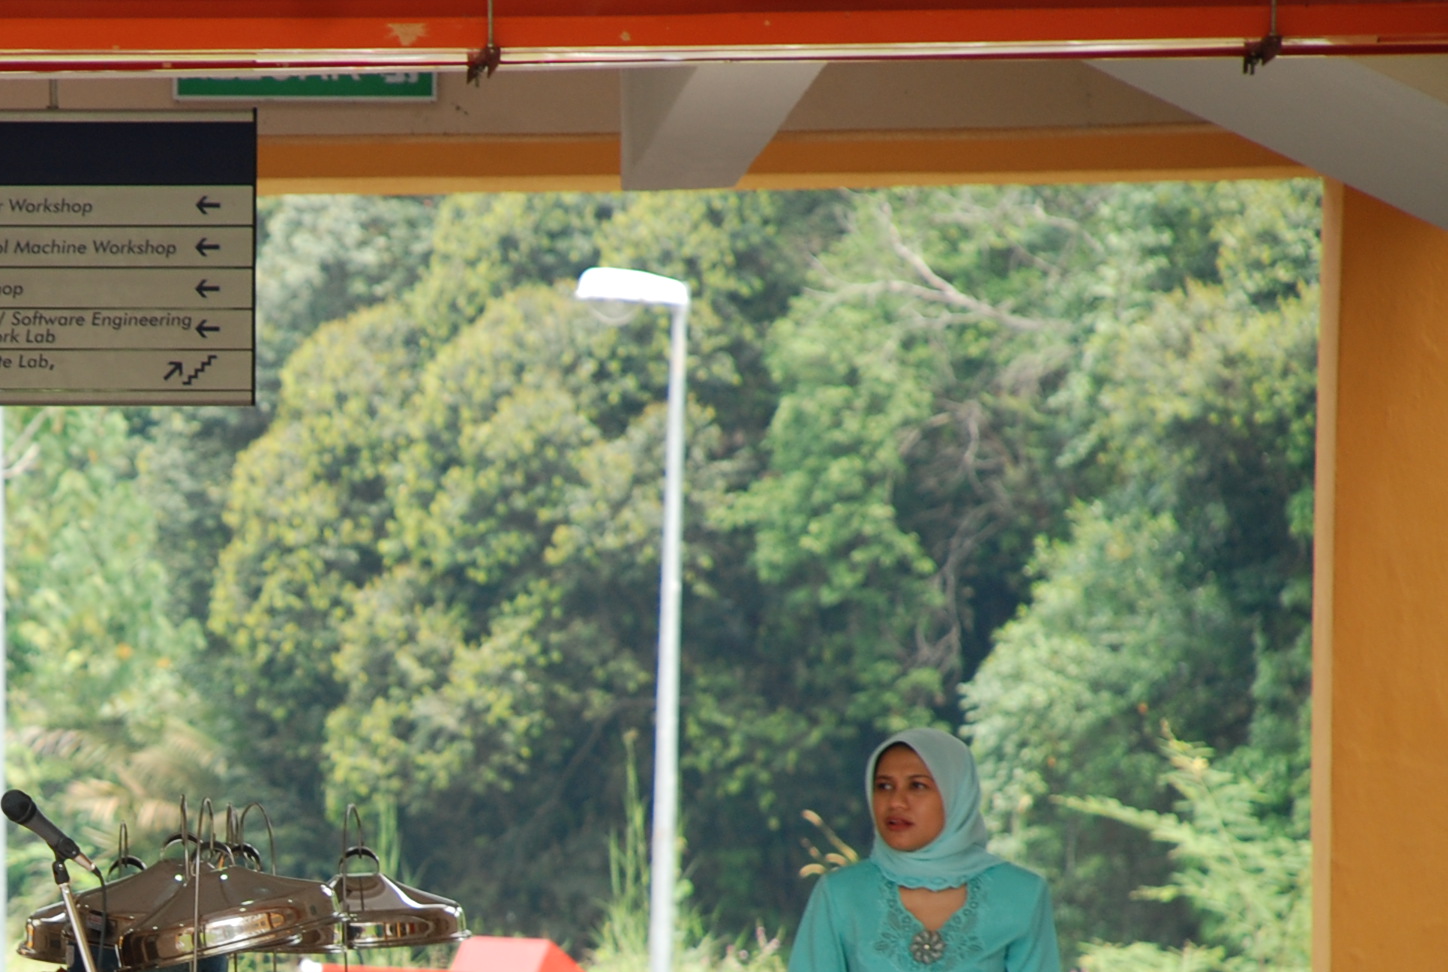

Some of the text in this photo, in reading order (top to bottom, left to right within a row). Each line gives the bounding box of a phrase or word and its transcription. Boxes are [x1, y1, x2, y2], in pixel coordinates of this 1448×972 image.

[8, 197, 93, 217] Workshop
[13, 239, 88, 255] Machine
[92, 239, 177, 258] Workshop
[11, 310, 86, 327] Software
[91, 311, 193, 331] Engineering
[25, 328, 56, 344] Lab
[18, 353, 55, 371] Lab,
